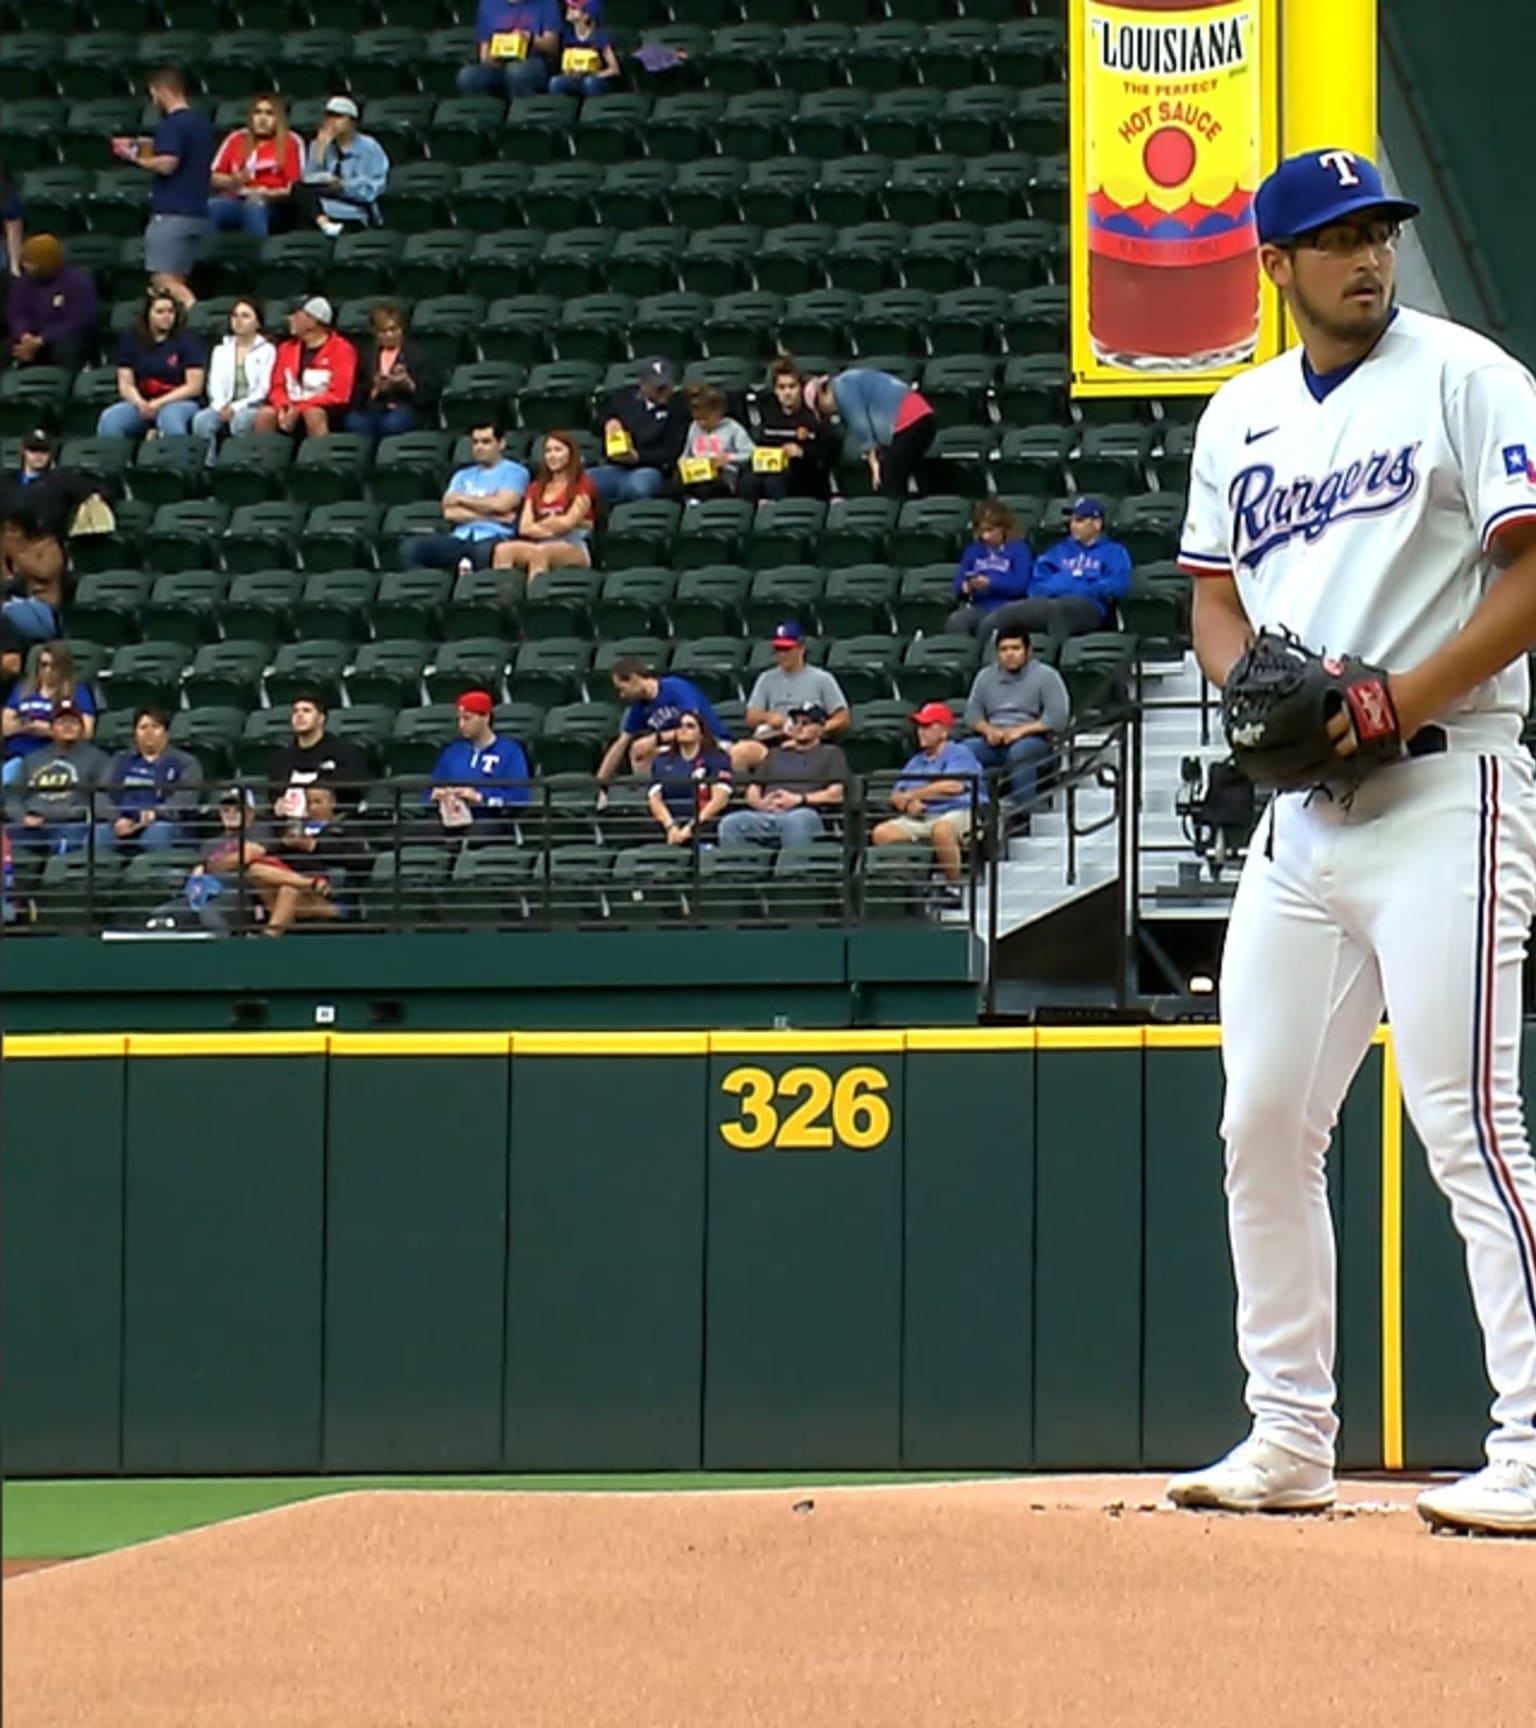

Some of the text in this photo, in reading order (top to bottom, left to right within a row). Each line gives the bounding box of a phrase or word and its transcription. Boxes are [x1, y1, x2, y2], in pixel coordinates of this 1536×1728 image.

[1123, 79, 1218, 97] THE PERFECT
[1118, 101, 1223, 145] HOT SAUCE
[1319, 150, 1359, 186] T
[1229, 440, 1423, 558] Rangers
[482, 753, 501, 773] T
[719, 1066, 891, 1149] 326
